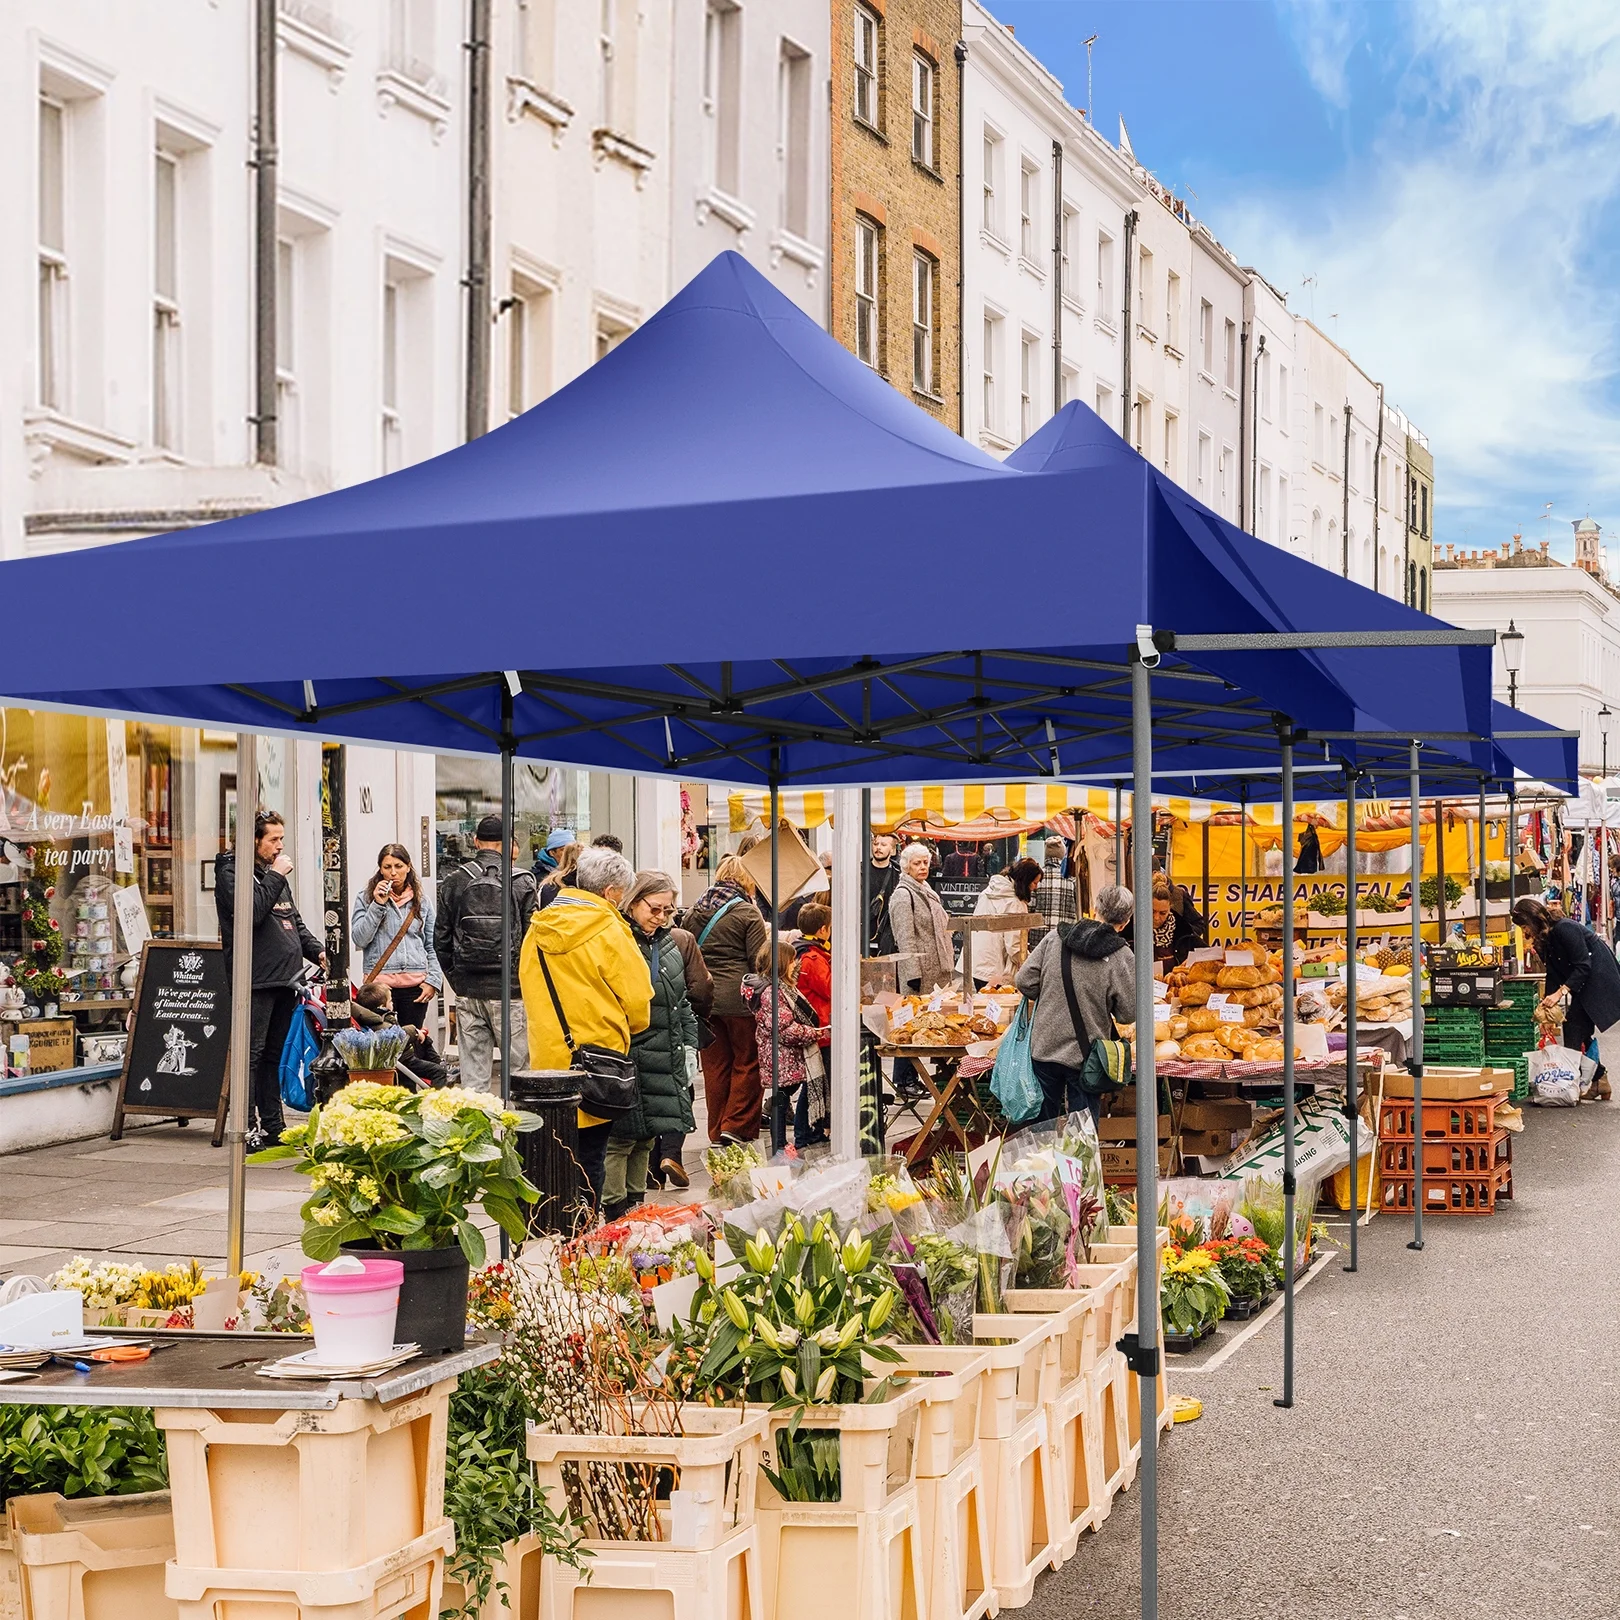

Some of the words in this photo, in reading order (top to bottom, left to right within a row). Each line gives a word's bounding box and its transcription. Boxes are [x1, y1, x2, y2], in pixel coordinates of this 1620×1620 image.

[25, 801, 39, 831] A
[43, 814, 78, 837] very
[44, 848, 68, 867] tea
[69, 846, 114, 873] party
[940, 883, 981, 892] VINTAGE
[173, 971, 204, 980] Whittard
[158, 988, 178, 998] We've
[177, 990, 192, 1000] got
[191, 990, 216, 1000] plenty
[154, 999, 164, 1010] of
[163, 999, 190, 1009] limited
[188, 1000, 215, 1010] edition
[155, 1009, 181, 1019] Easter
[1294, 1147, 1318, 1168] AISING
